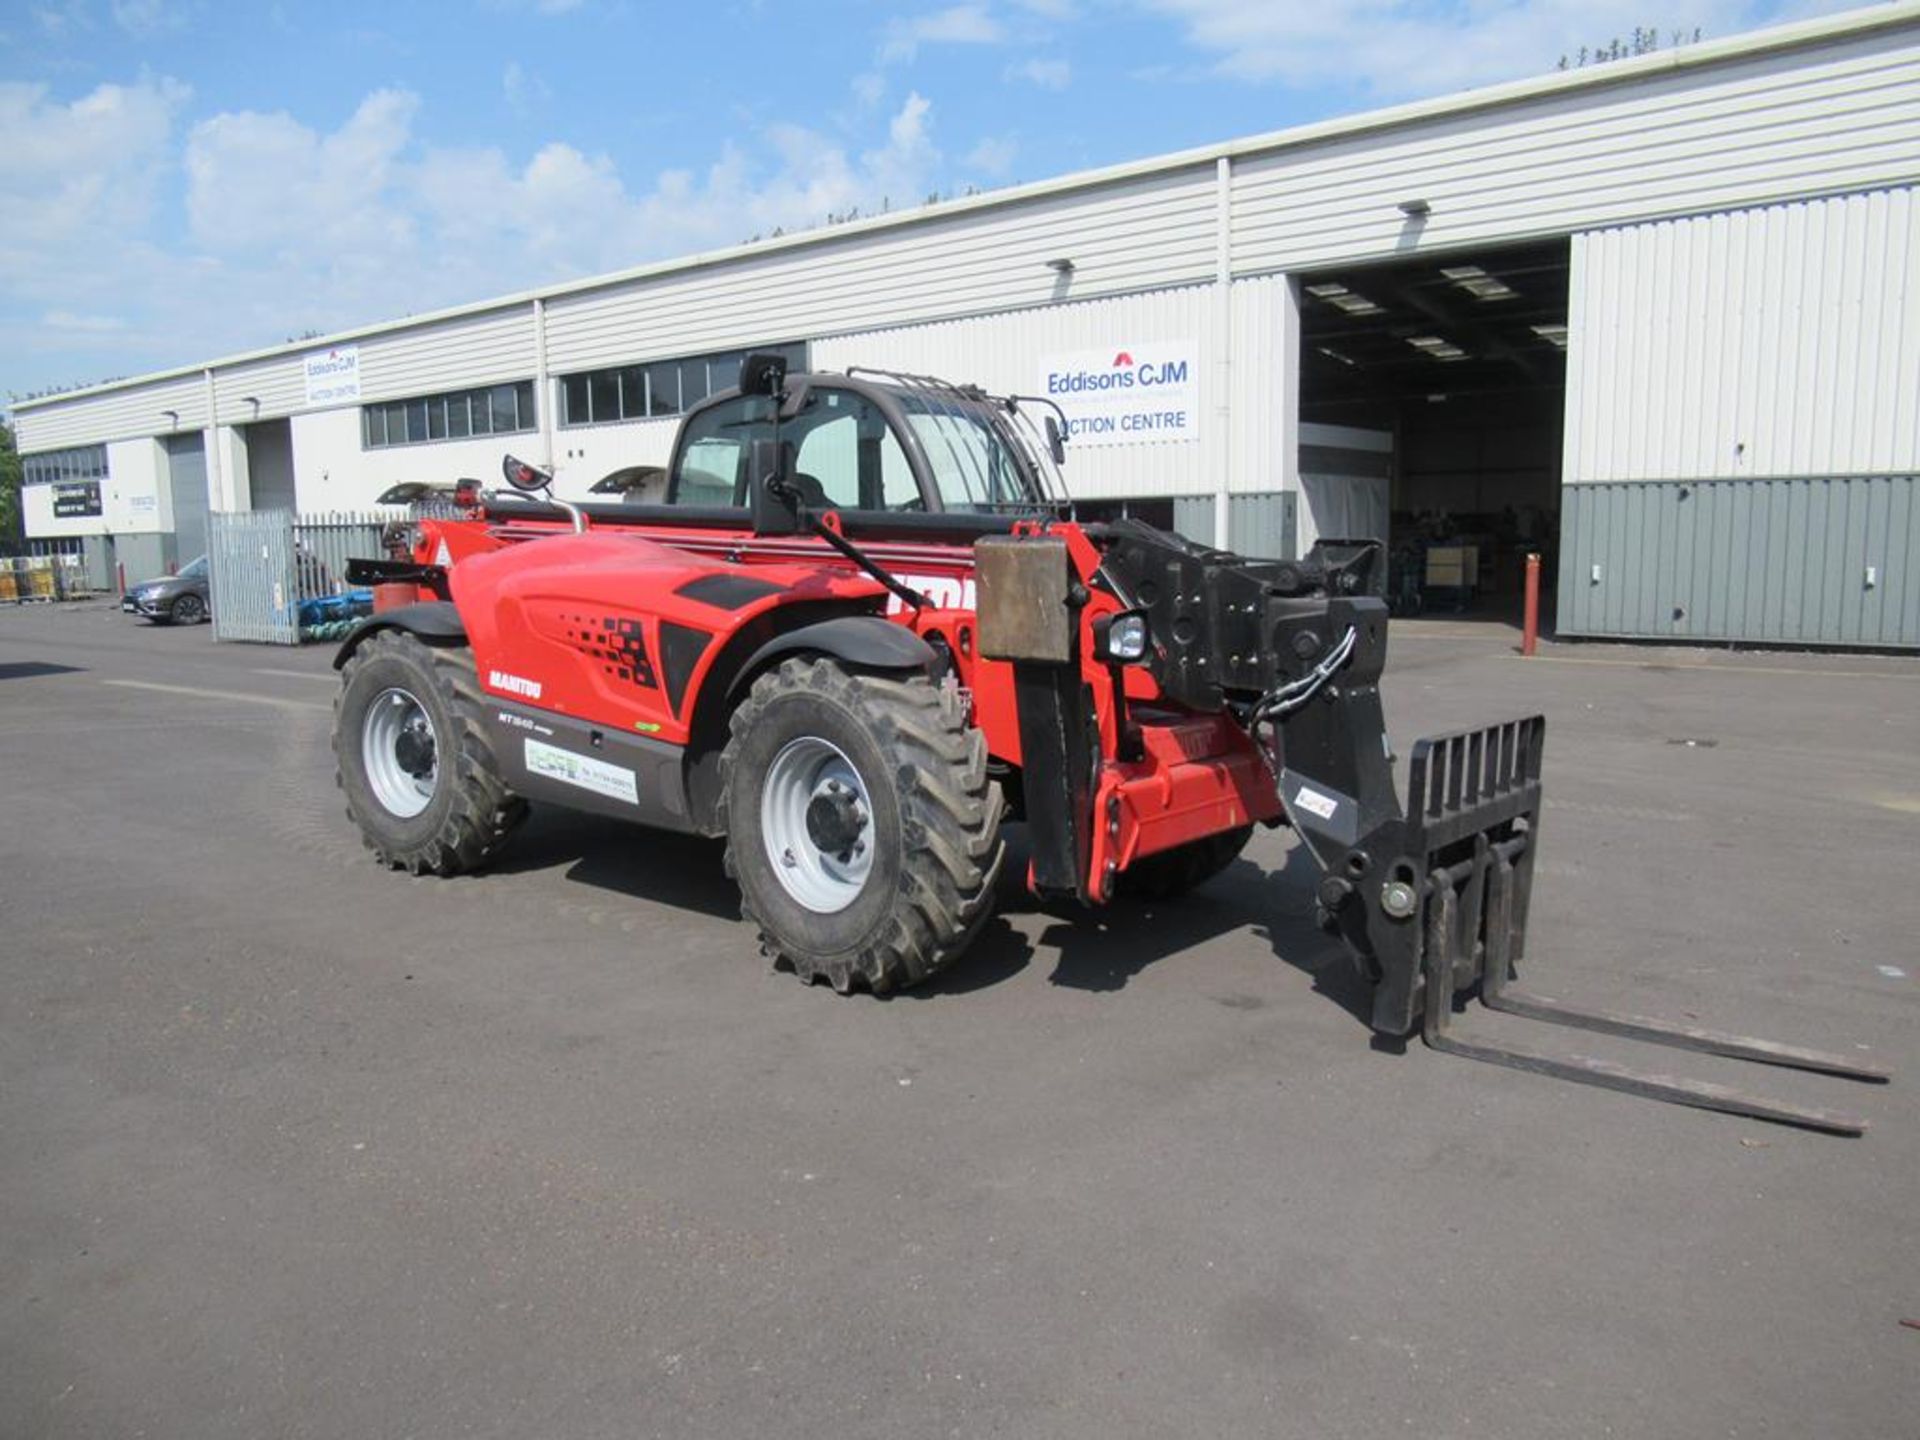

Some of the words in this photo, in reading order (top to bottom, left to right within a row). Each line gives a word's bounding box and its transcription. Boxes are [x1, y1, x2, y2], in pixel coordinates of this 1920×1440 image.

[1049, 372, 1134, 393] Eddisons
[1138, 361, 1187, 385] CJM
[1059, 417, 1115, 435] UCTION
[1121, 411, 1186, 430] CENTRE
[490, 671, 541, 698] MANITOU
